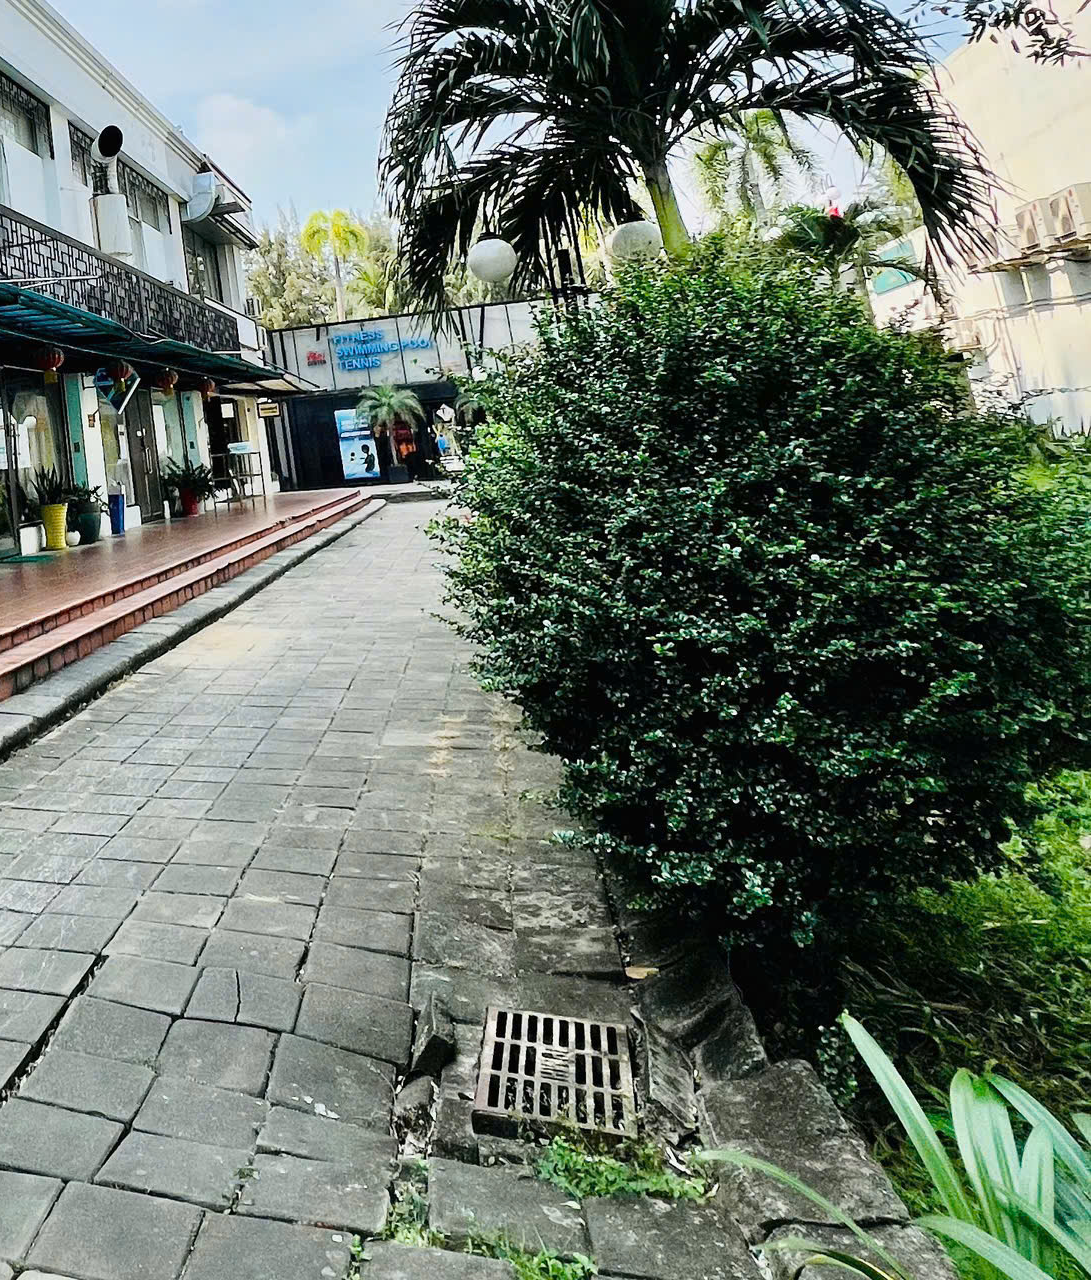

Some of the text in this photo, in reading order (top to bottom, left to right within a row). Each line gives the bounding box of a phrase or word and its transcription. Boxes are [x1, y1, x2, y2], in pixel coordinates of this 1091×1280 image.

[333, 328, 384, 345] FITNESS
[335, 340, 399, 359] SWIMMING
[339, 356, 381, 371] TENNIS
